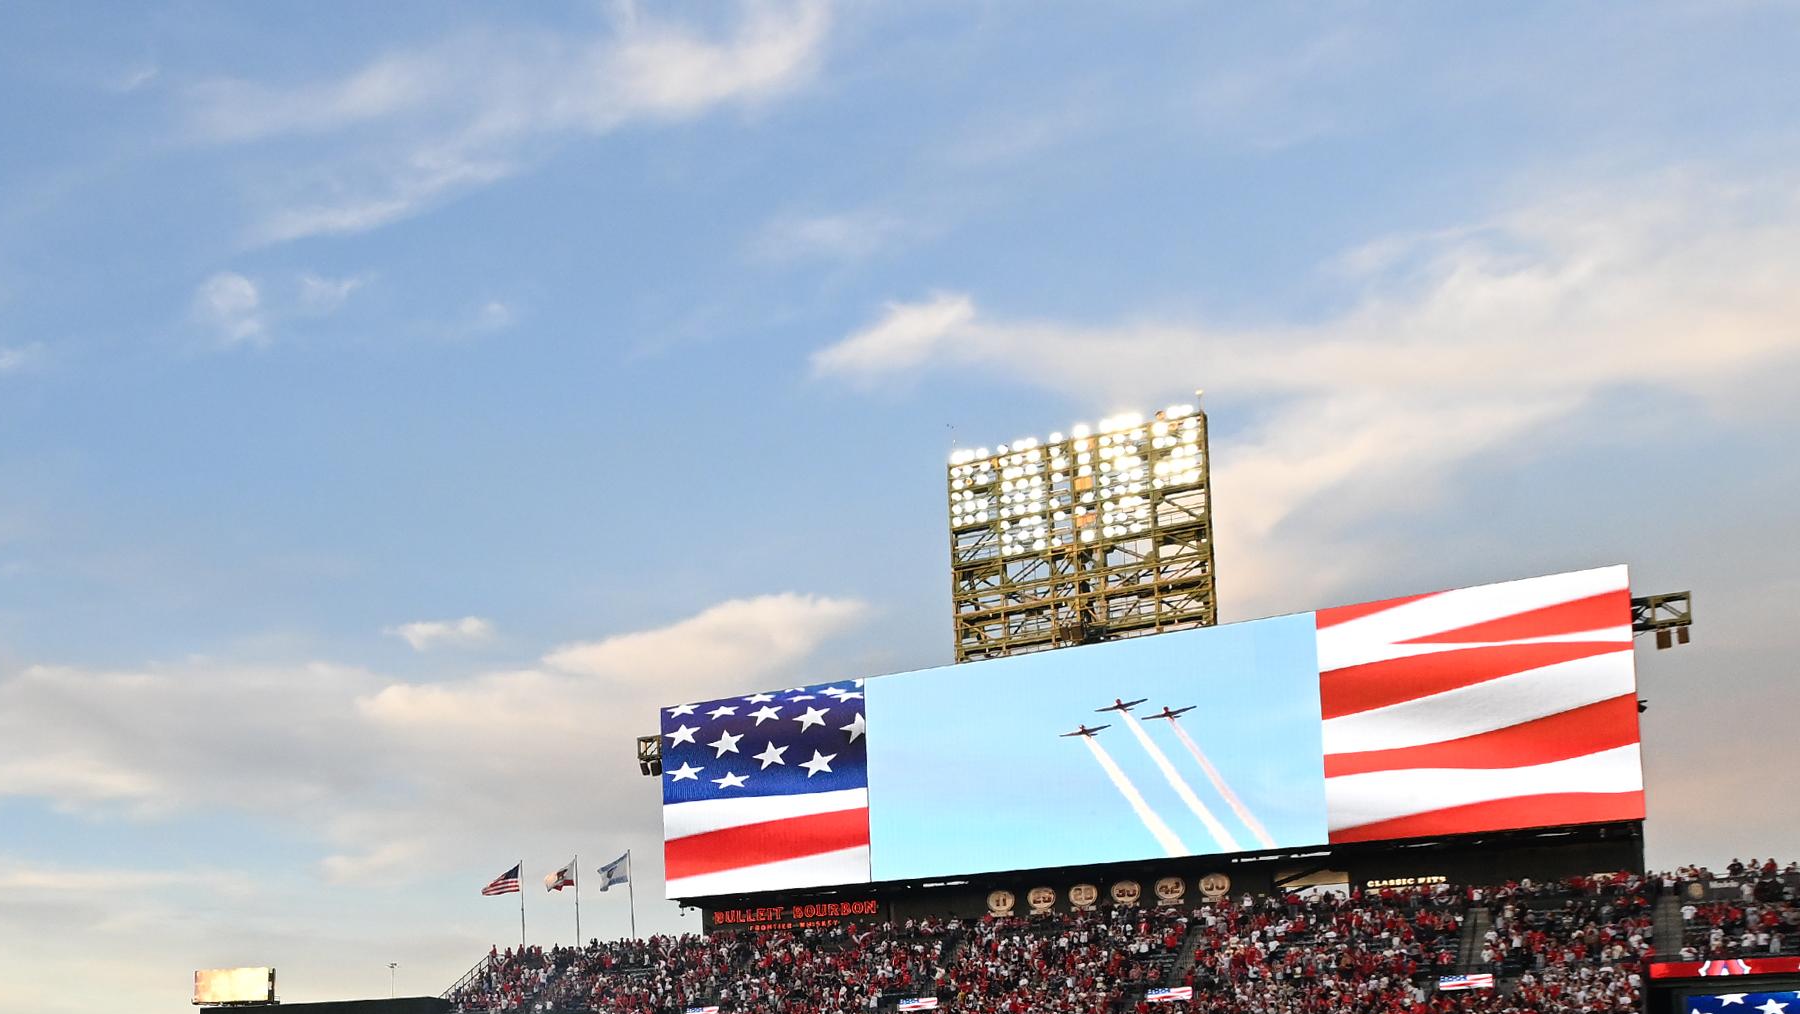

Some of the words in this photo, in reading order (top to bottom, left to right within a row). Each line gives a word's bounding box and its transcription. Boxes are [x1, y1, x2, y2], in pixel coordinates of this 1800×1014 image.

[1367, 878, 1415, 888] CLASSIC
[714, 907, 784, 925] BULLEIT
[793, 900, 878, 919] BOURBON
